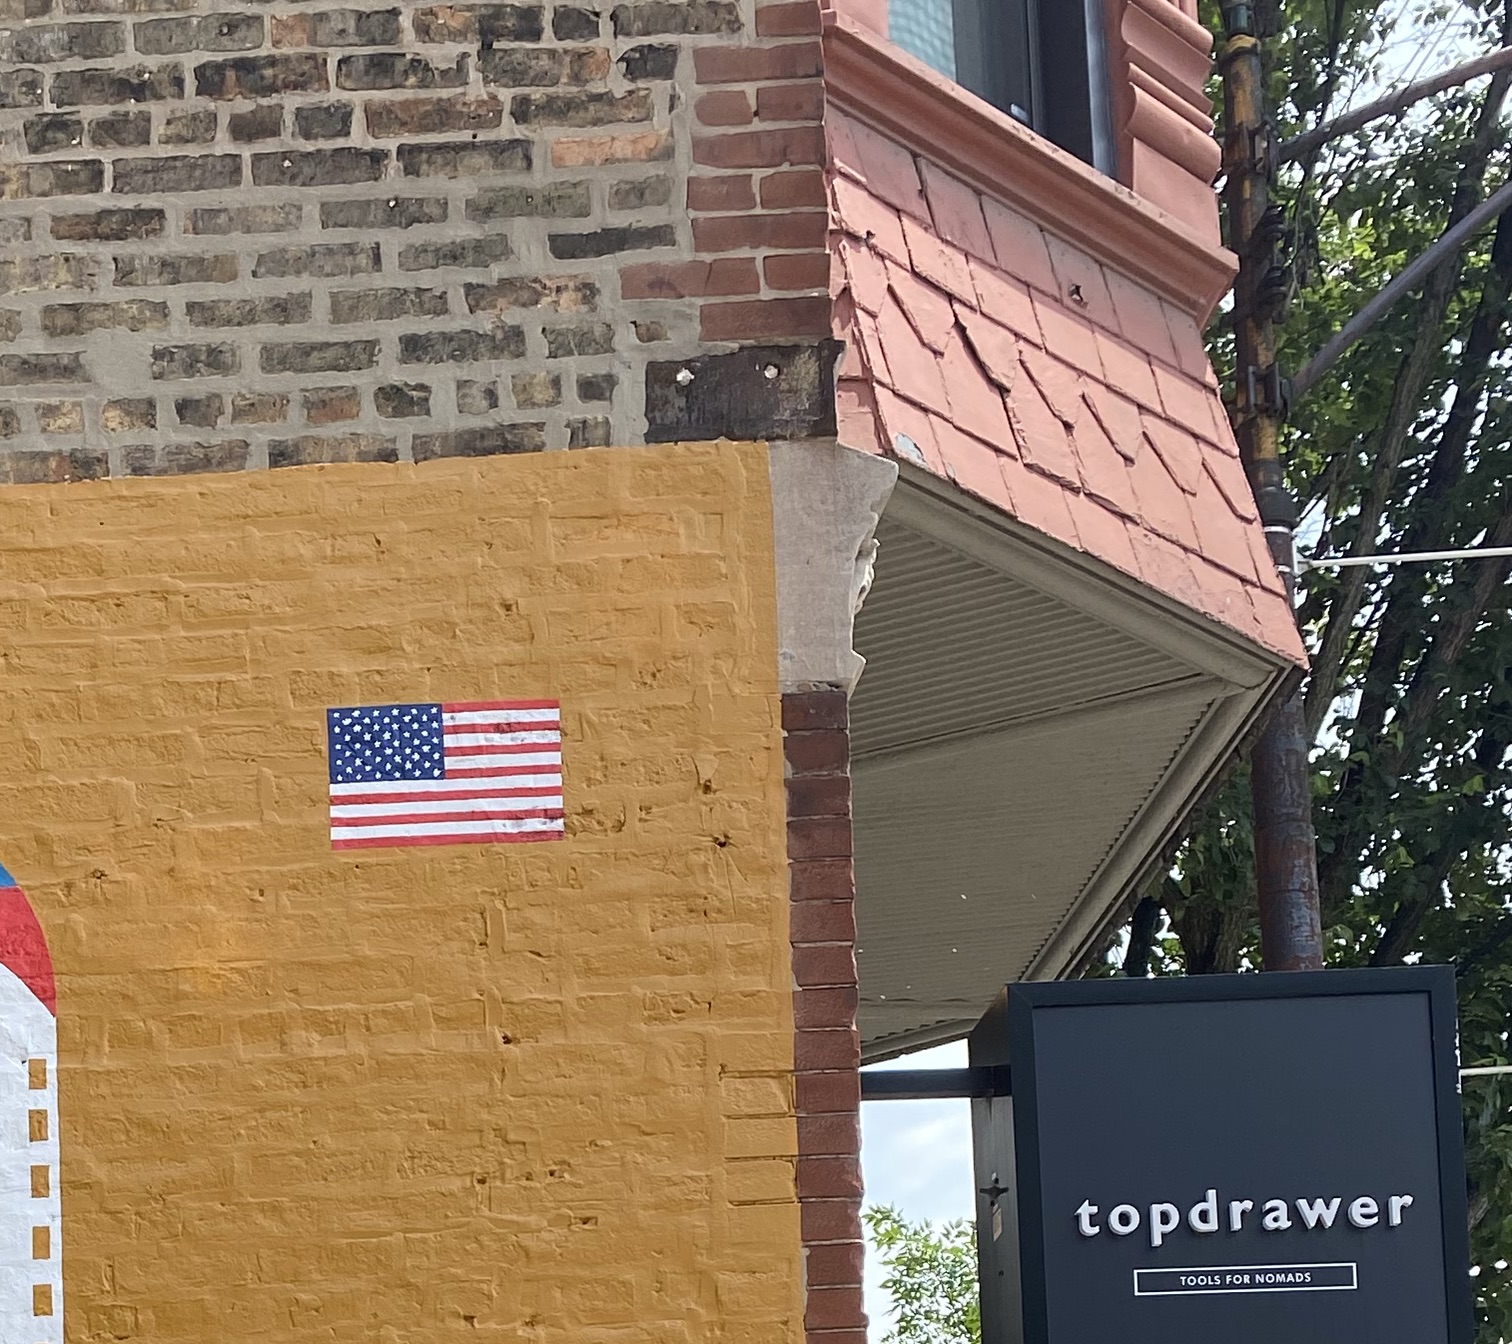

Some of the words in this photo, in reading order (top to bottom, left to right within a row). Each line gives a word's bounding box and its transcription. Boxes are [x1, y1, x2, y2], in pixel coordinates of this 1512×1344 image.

[1074, 1189, 1414, 1248] topdrawer
[1179, 1275, 1222, 1287] TOOLS
[1226, 1274, 1251, 1285] FOR
[1255, 1272, 1312, 1284] NOMADS
